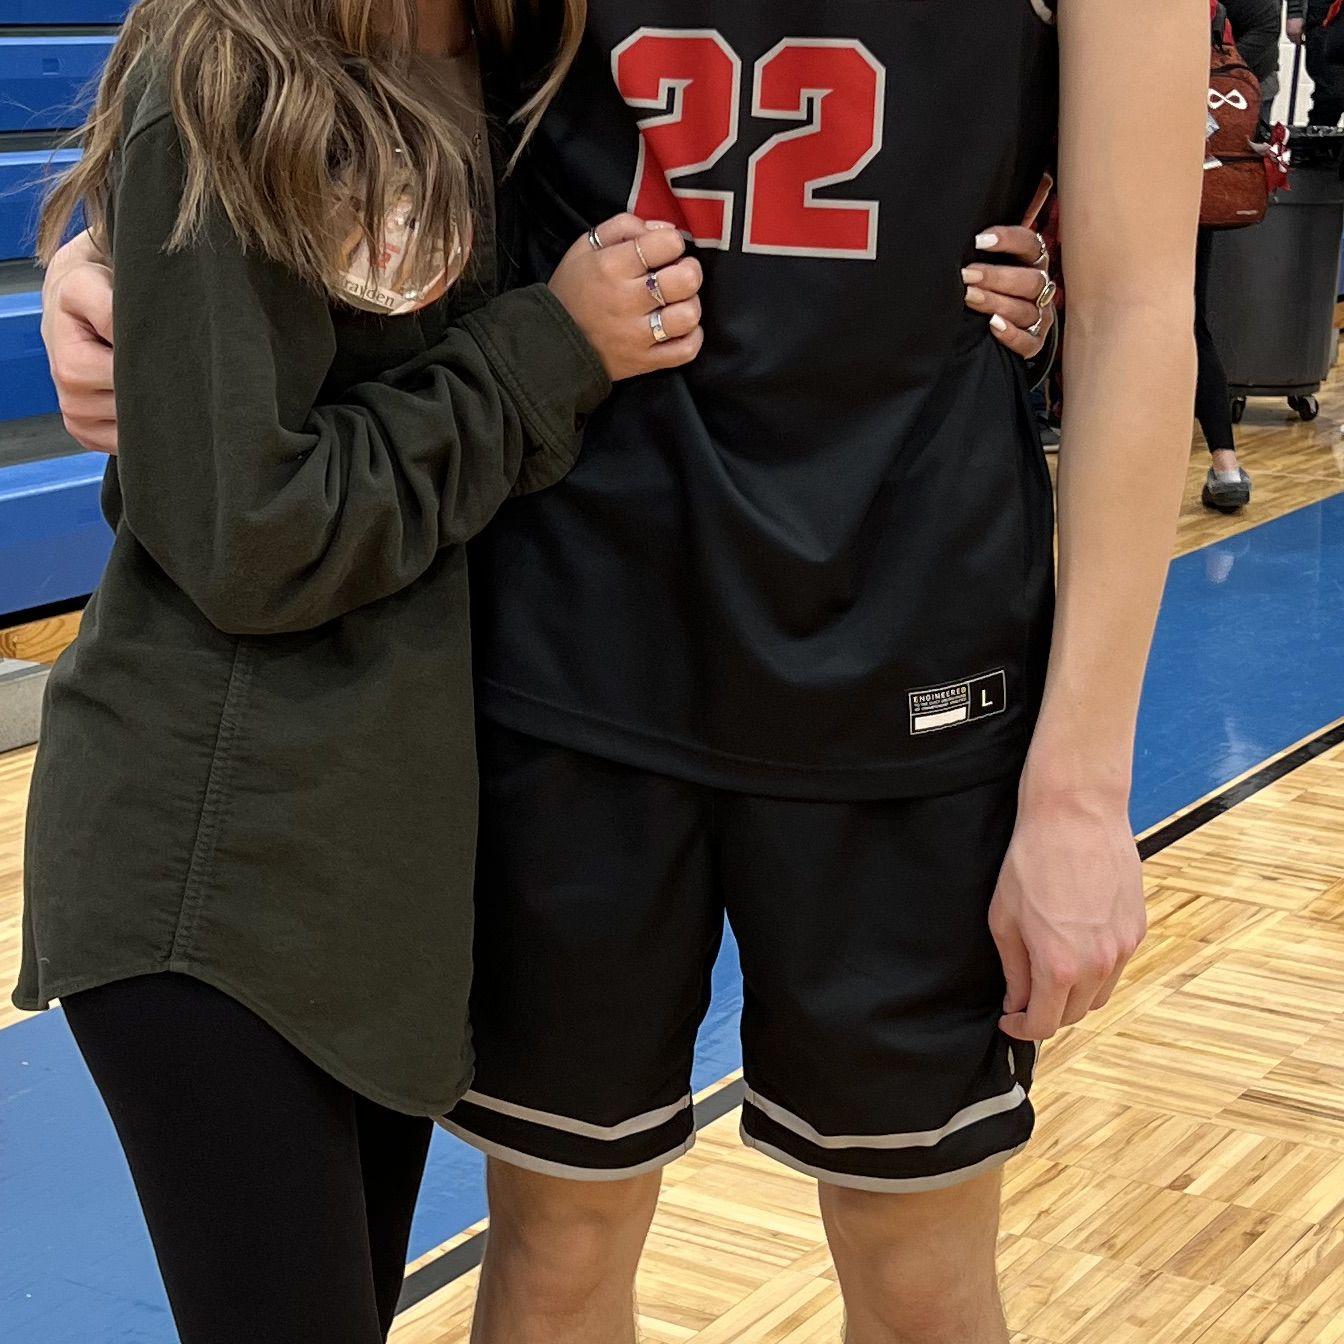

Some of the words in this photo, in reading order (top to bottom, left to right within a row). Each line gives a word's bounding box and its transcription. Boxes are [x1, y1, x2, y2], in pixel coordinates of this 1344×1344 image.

[611, 27, 887, 260] 22
[341, 273, 396, 307] rayden
[981, 689, 994, 708] L
